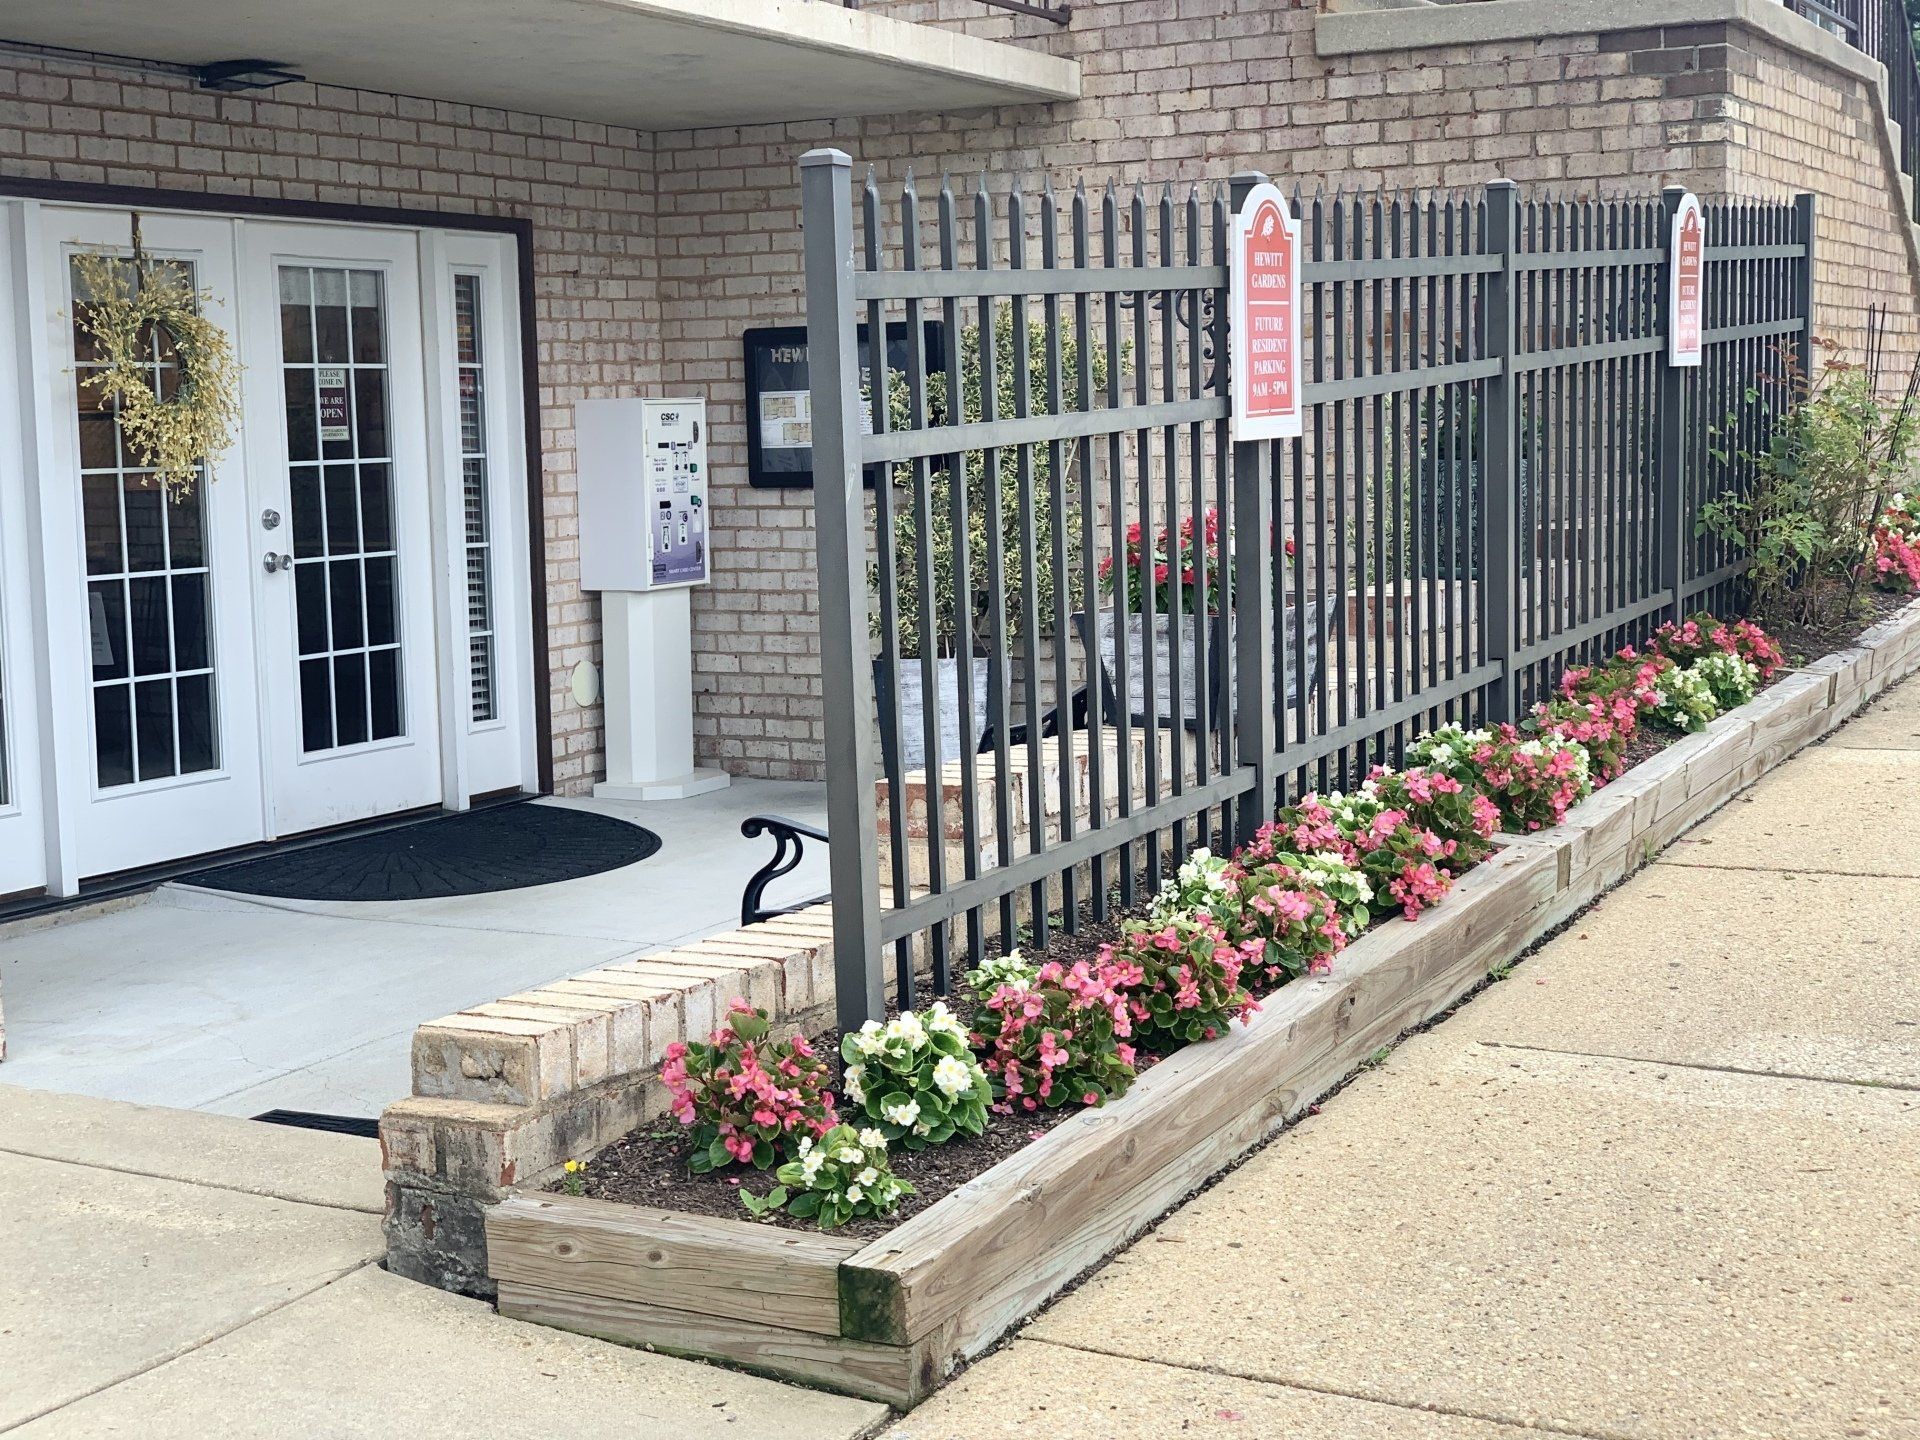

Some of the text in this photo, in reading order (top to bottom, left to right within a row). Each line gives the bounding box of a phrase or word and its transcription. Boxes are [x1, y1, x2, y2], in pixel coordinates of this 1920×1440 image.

[1254, 251, 1284, 267] HEWITT
[1251, 273, 1286, 289] GARDENS
[1254, 316, 1284, 332] FUTURE
[1251, 338, 1288, 354] RESIDENT
[1253, 359, 1286, 376] PARKING
[1252, 381, 1268, 397] 9AM
[1272, 380, 1288, 396] 5PM
[330, 396, 344, 405] ARE
[320, 408, 344, 419] OPEN
[661, 412, 675, 421] CSC
